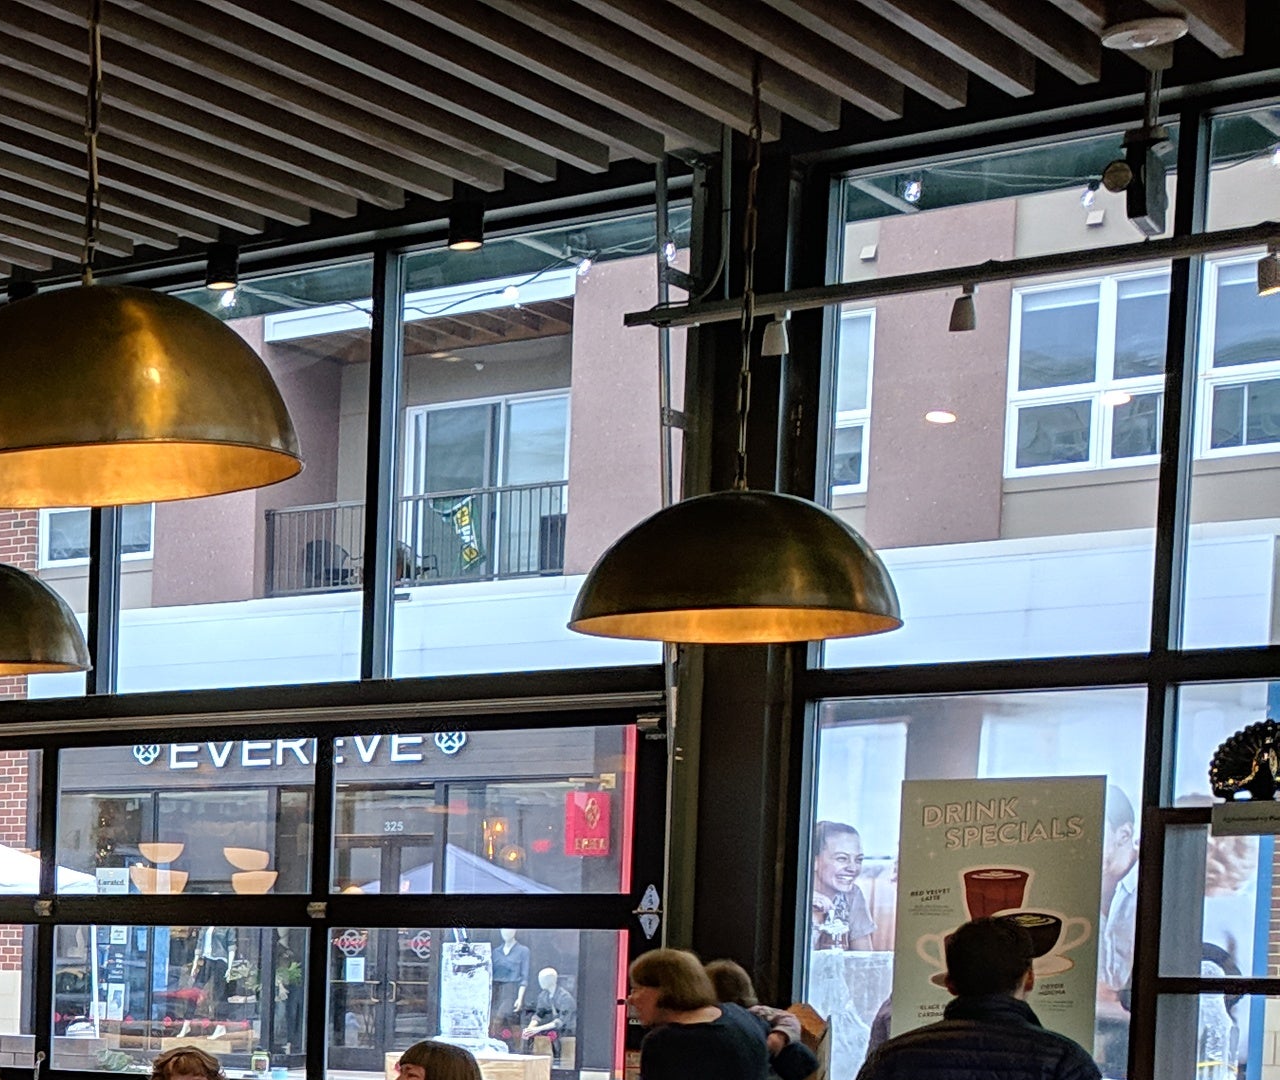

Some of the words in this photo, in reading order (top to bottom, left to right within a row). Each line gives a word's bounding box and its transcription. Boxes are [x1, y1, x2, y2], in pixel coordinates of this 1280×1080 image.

[384, 821, 404, 832] 325
[922, 796, 1018, 829] DRINK
[944, 816, 1085, 850] SPECIALS
